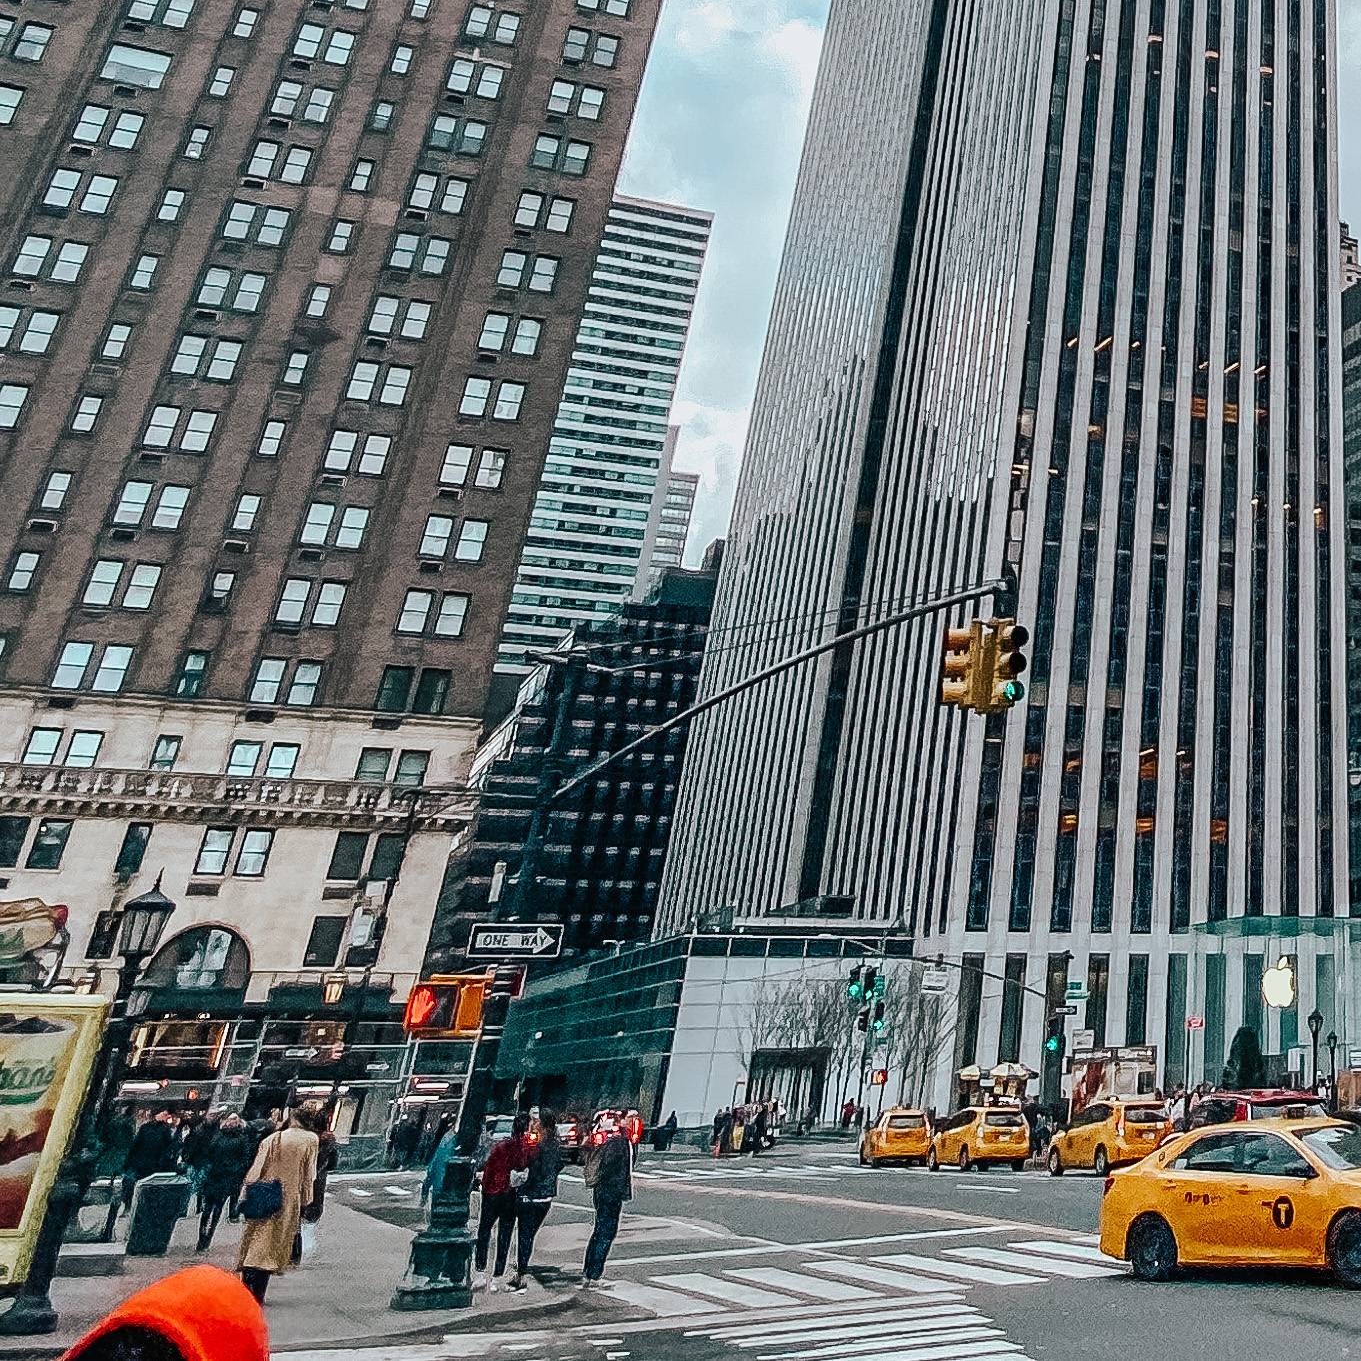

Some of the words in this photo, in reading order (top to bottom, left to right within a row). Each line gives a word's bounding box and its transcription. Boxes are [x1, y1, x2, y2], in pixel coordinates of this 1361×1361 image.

[483, 934, 509, 947] ONE
[520, 934, 547, 947] WAY
[1277, 1202, 1290, 1226] T
